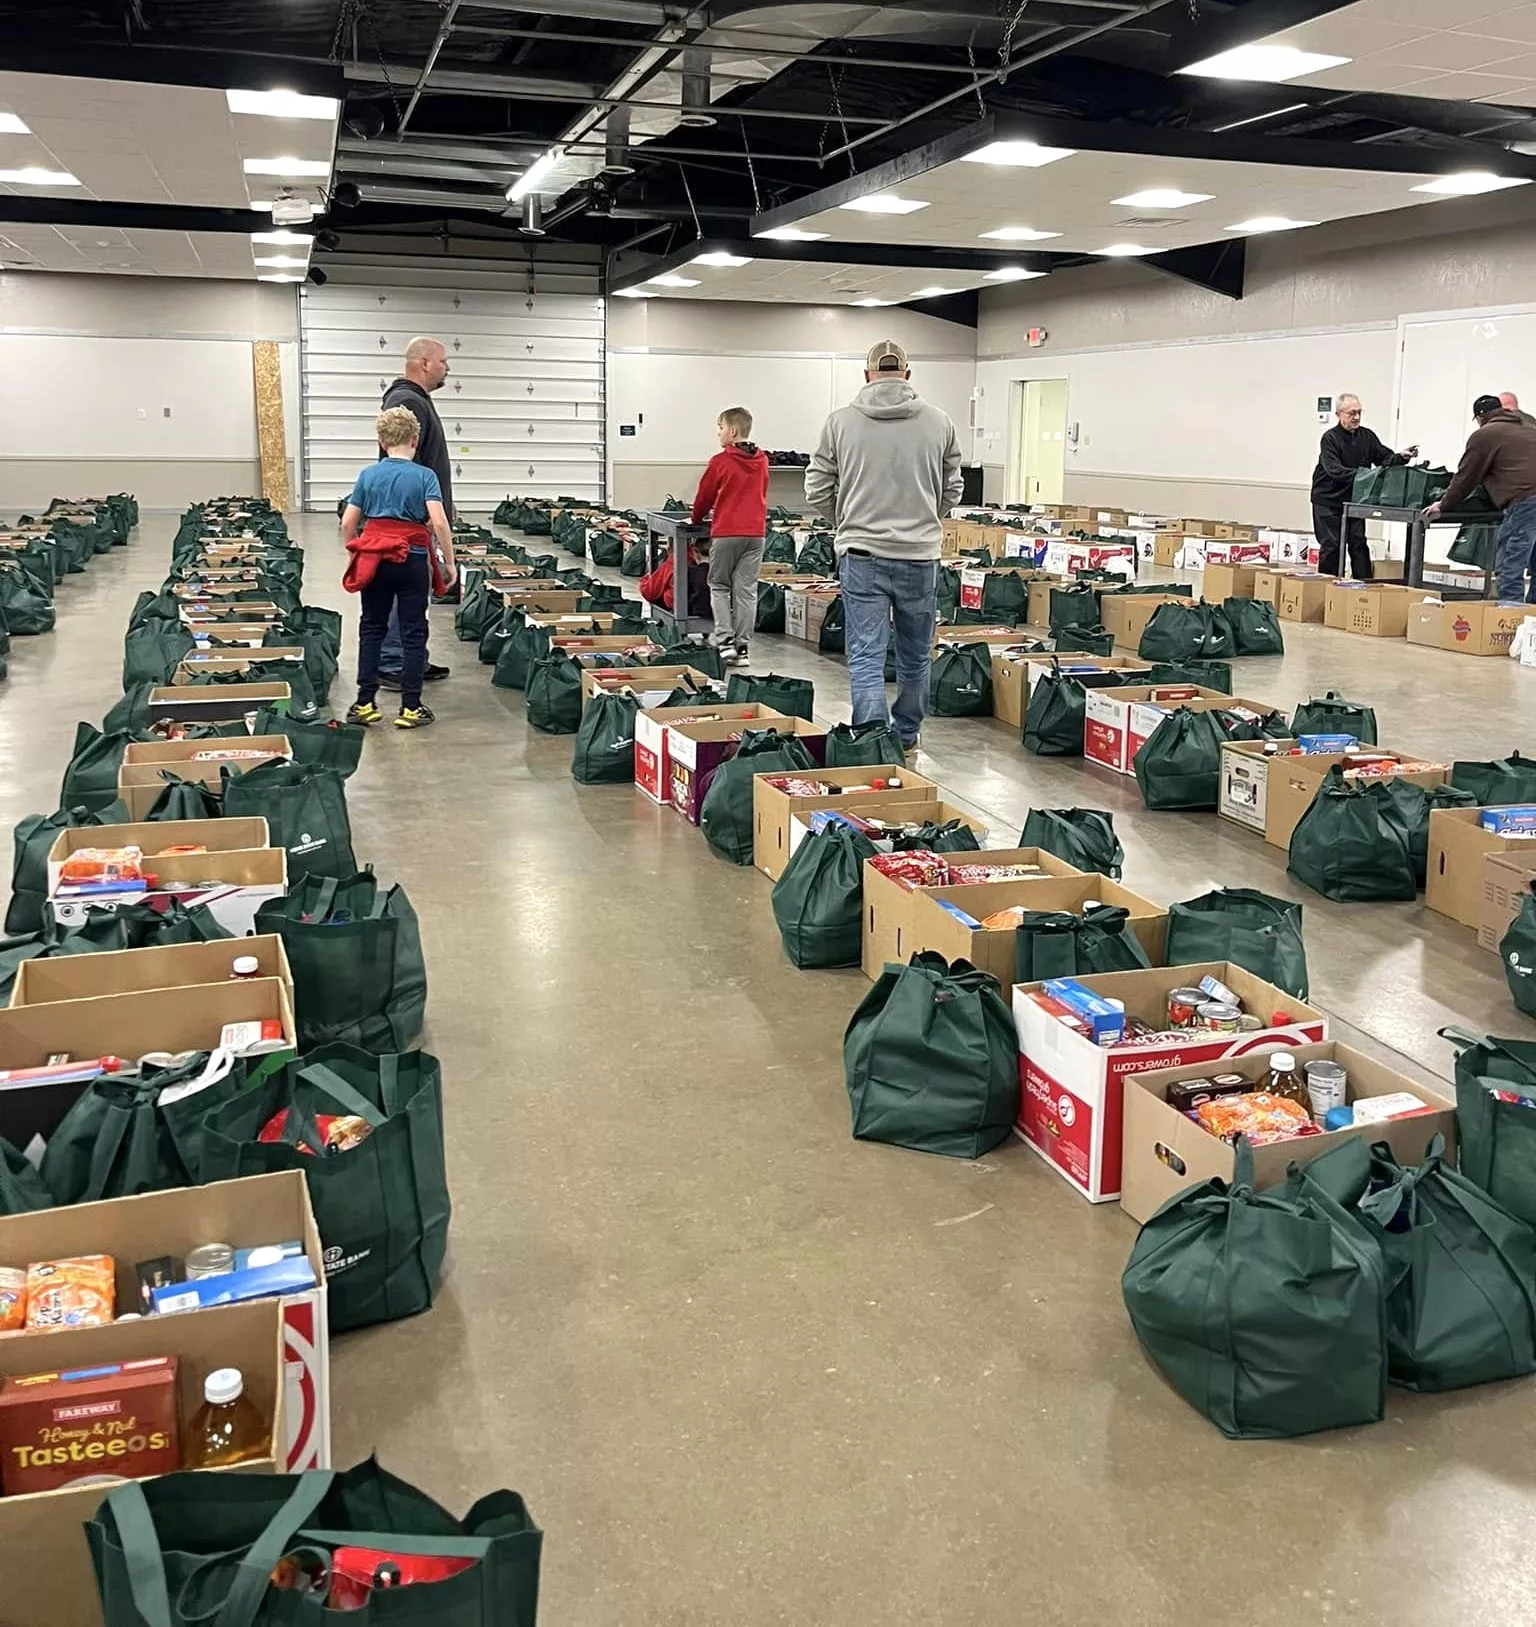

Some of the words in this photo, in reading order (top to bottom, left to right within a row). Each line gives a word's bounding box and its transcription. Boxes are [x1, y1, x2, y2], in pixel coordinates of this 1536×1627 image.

[1112, 1054, 1182, 1073] growers.com
[58, 1403, 116, 1419] FAREWAY
[38, 1426, 91, 1444] Honey
[90, 1422, 105, 1436] &
[106, 1416, 137, 1436] Nut
